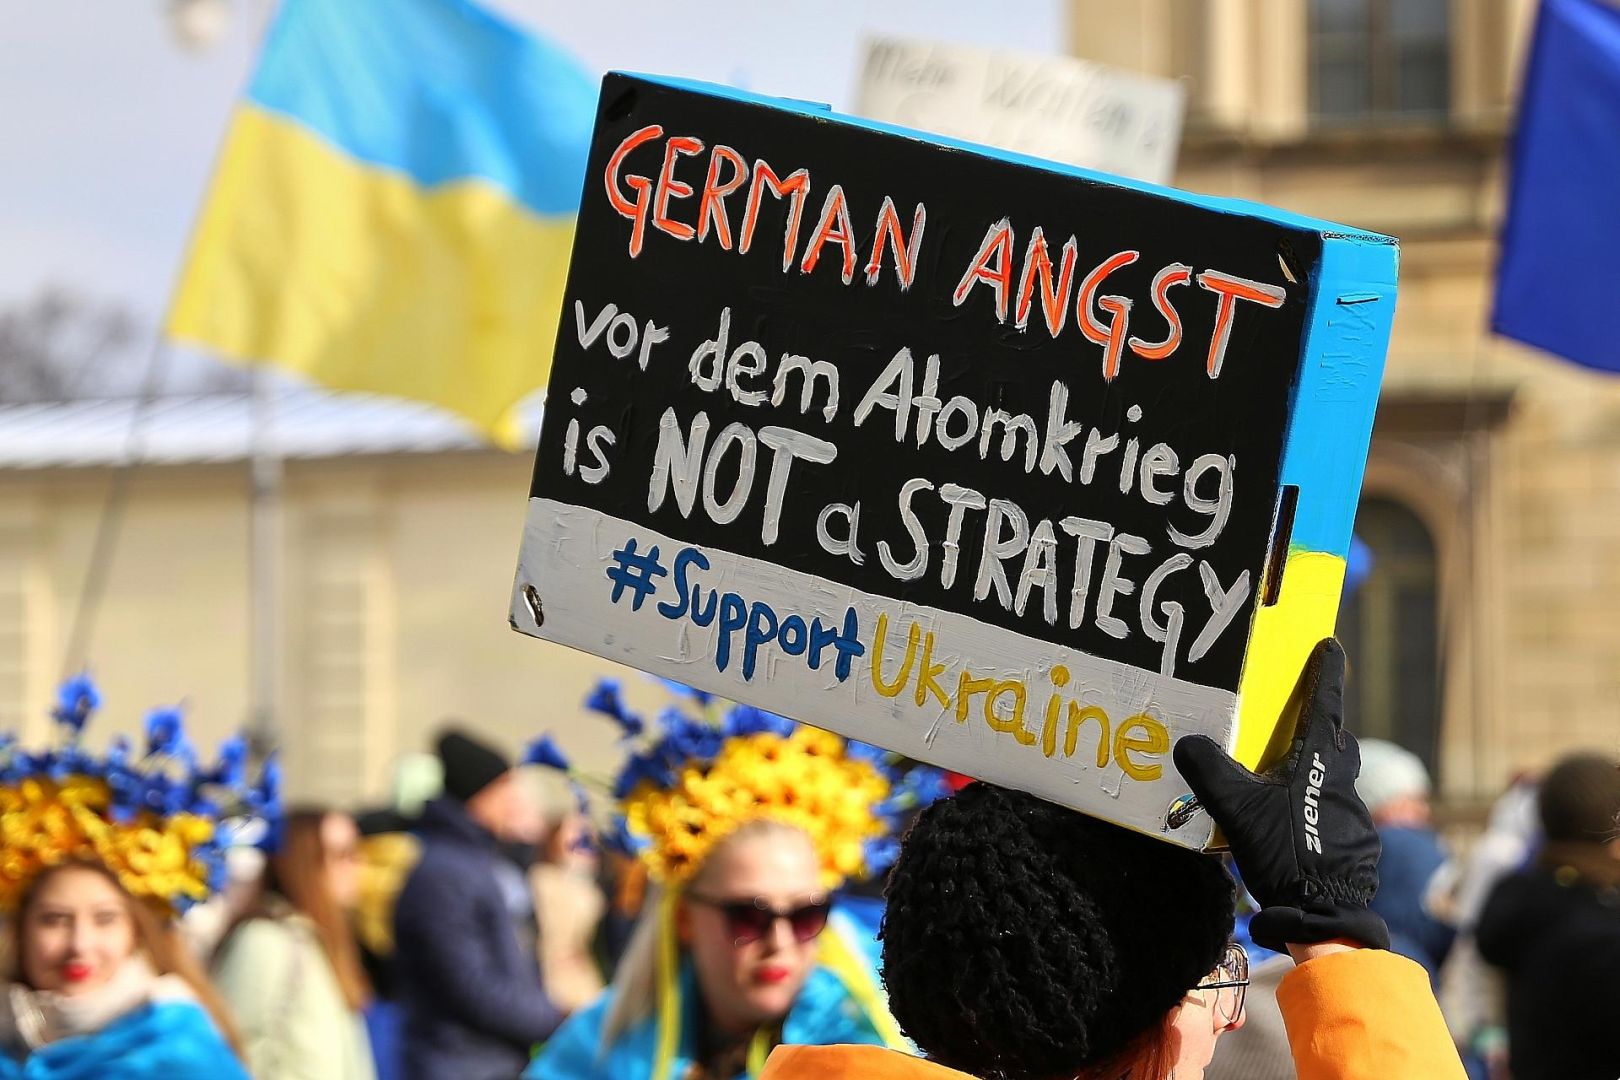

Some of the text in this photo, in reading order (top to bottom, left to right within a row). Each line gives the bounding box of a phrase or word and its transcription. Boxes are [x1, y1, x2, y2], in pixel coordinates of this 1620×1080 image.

[604, 125, 1286, 381] GERMAN ANGST
[563, 387, 1251, 679] is NOT a STRATEGY
[574, 300, 1236, 549] vor dem Atomkrieg
[1303, 752, 1326, 855] ziener
